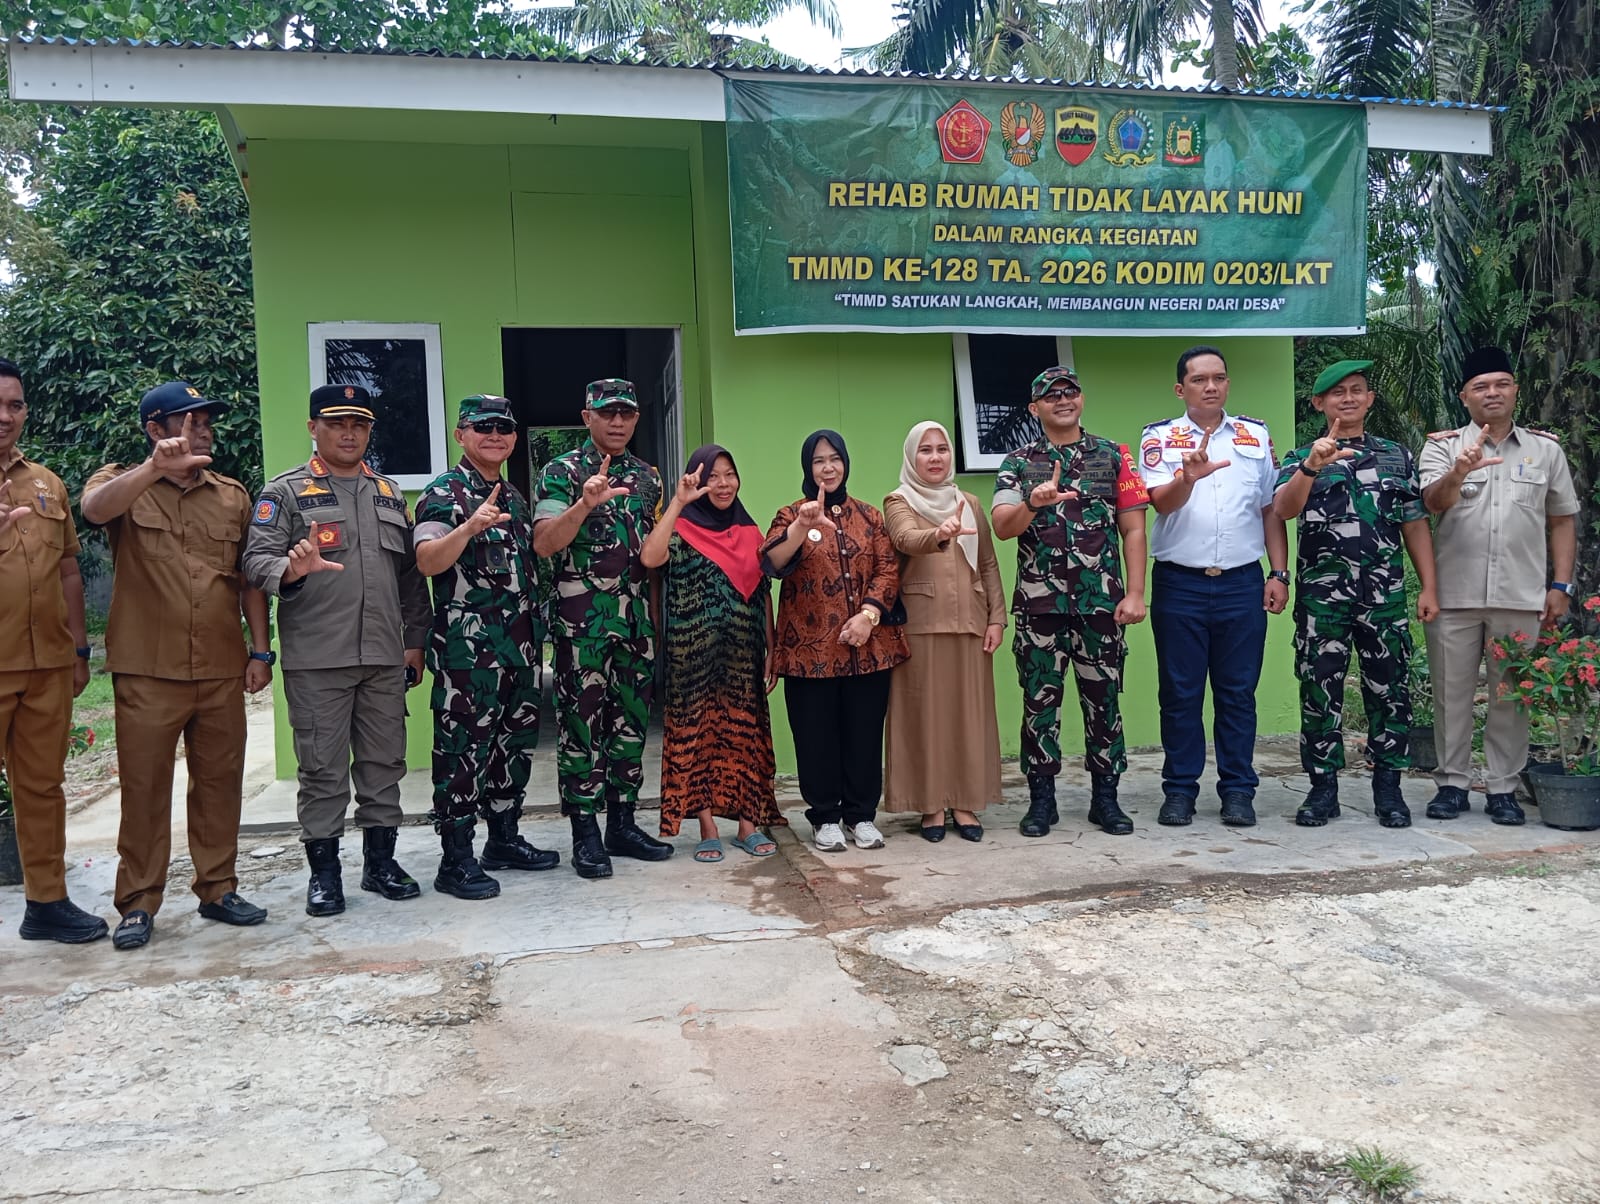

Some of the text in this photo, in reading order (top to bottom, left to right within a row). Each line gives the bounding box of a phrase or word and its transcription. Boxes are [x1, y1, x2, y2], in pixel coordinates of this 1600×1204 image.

[829, 182, 1302, 213] REHAB RUMAH TIDAK LAYAK HUNI
[934, 224, 1197, 244] DALAM RANGKA KEGIATAN
[788, 256, 1333, 284] TMMD KE-128 TA. 2026 KODIM 0203/LKT
[892, 295, 961, 308] SATUKAN
[965, 295, 1042, 311] LANGKAH,
[1047, 297, 1145, 310] MEMBANGUN
[1149, 298, 1202, 311] NEGERI
[1207, 298, 1239, 310] DARI
